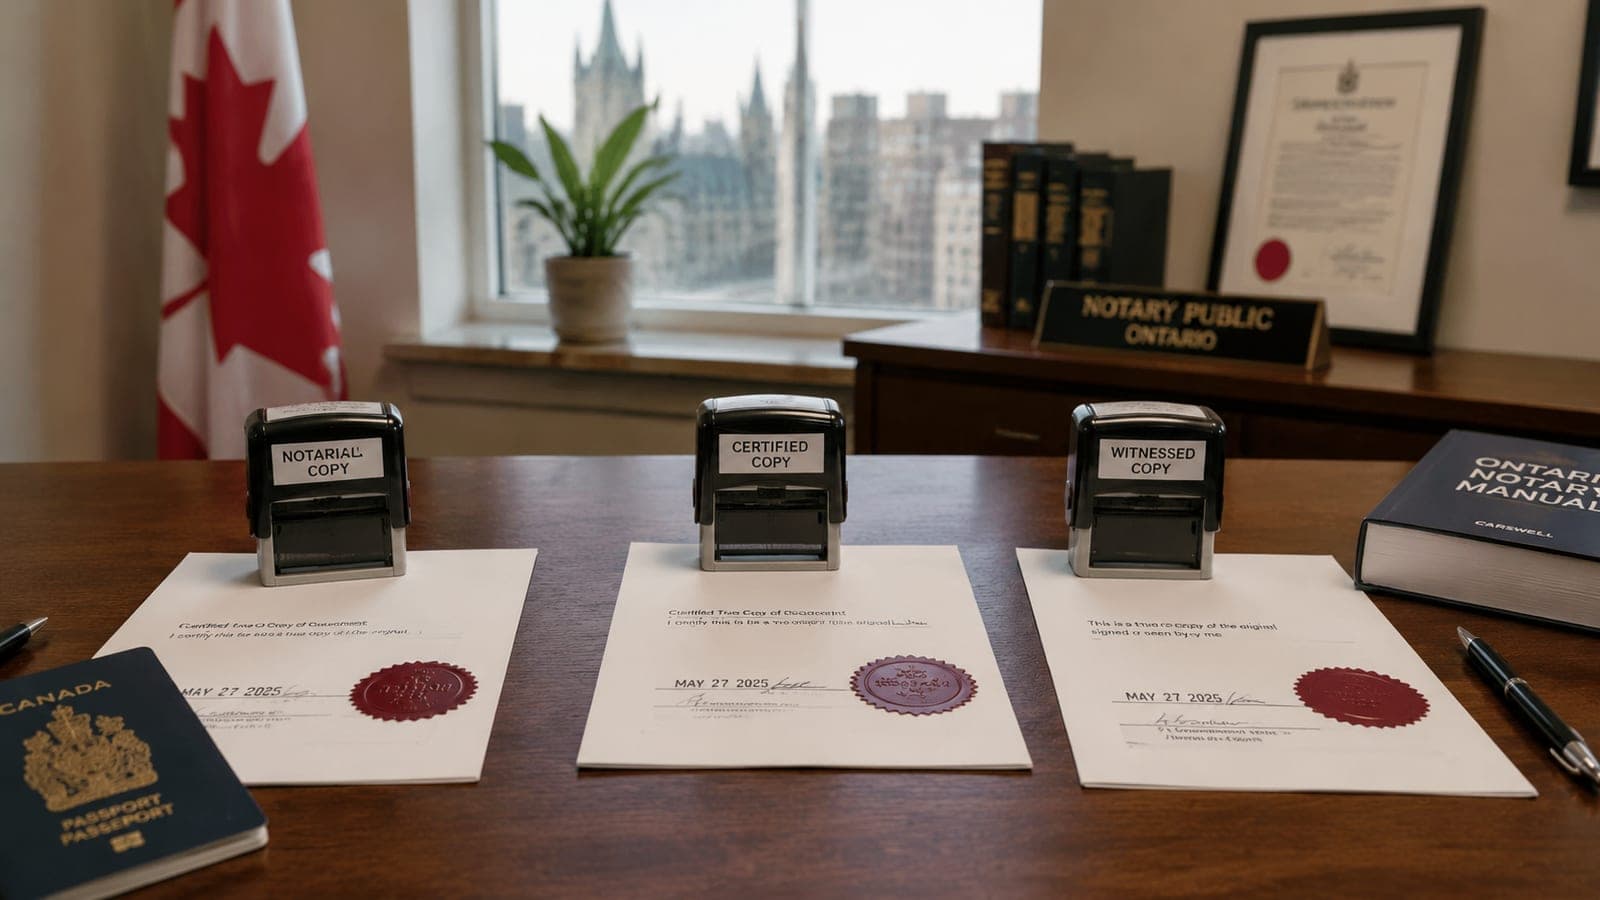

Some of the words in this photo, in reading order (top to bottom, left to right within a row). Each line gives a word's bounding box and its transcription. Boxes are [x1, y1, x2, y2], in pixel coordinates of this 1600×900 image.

[1082, 295, 1178, 322] NOTARY
[1182, 301, 1275, 331] PUBLIC
[1124, 323, 1218, 351] ONTARIO
[732, 440, 809, 453] CERTIFIED
[1111, 446, 1196, 460] WITNESSED
[751, 456, 791, 469] COPY
[1131, 463, 1172, 475] COPY
[308, 463, 350, 477] COPY
[1455, 479, 1600, 512] MANUAL
[1474, 520, 1554, 539] CARSWELL
[675, 679, 705, 689] MAY
[711, 679, 729, 688] 27
[736, 678, 769, 688] 2025
[0, 679, 112, 716] CANADA
[182, 687, 213, 697] MAY
[218, 687, 239, 697] 27
[243, 686, 283, 697] 2025
[1125, 691, 1156, 703] MAY
[1163, 692, 1180, 704] 27
[1187, 692, 1223, 705] 2025
[61, 793, 161, 831] PASSPORT
